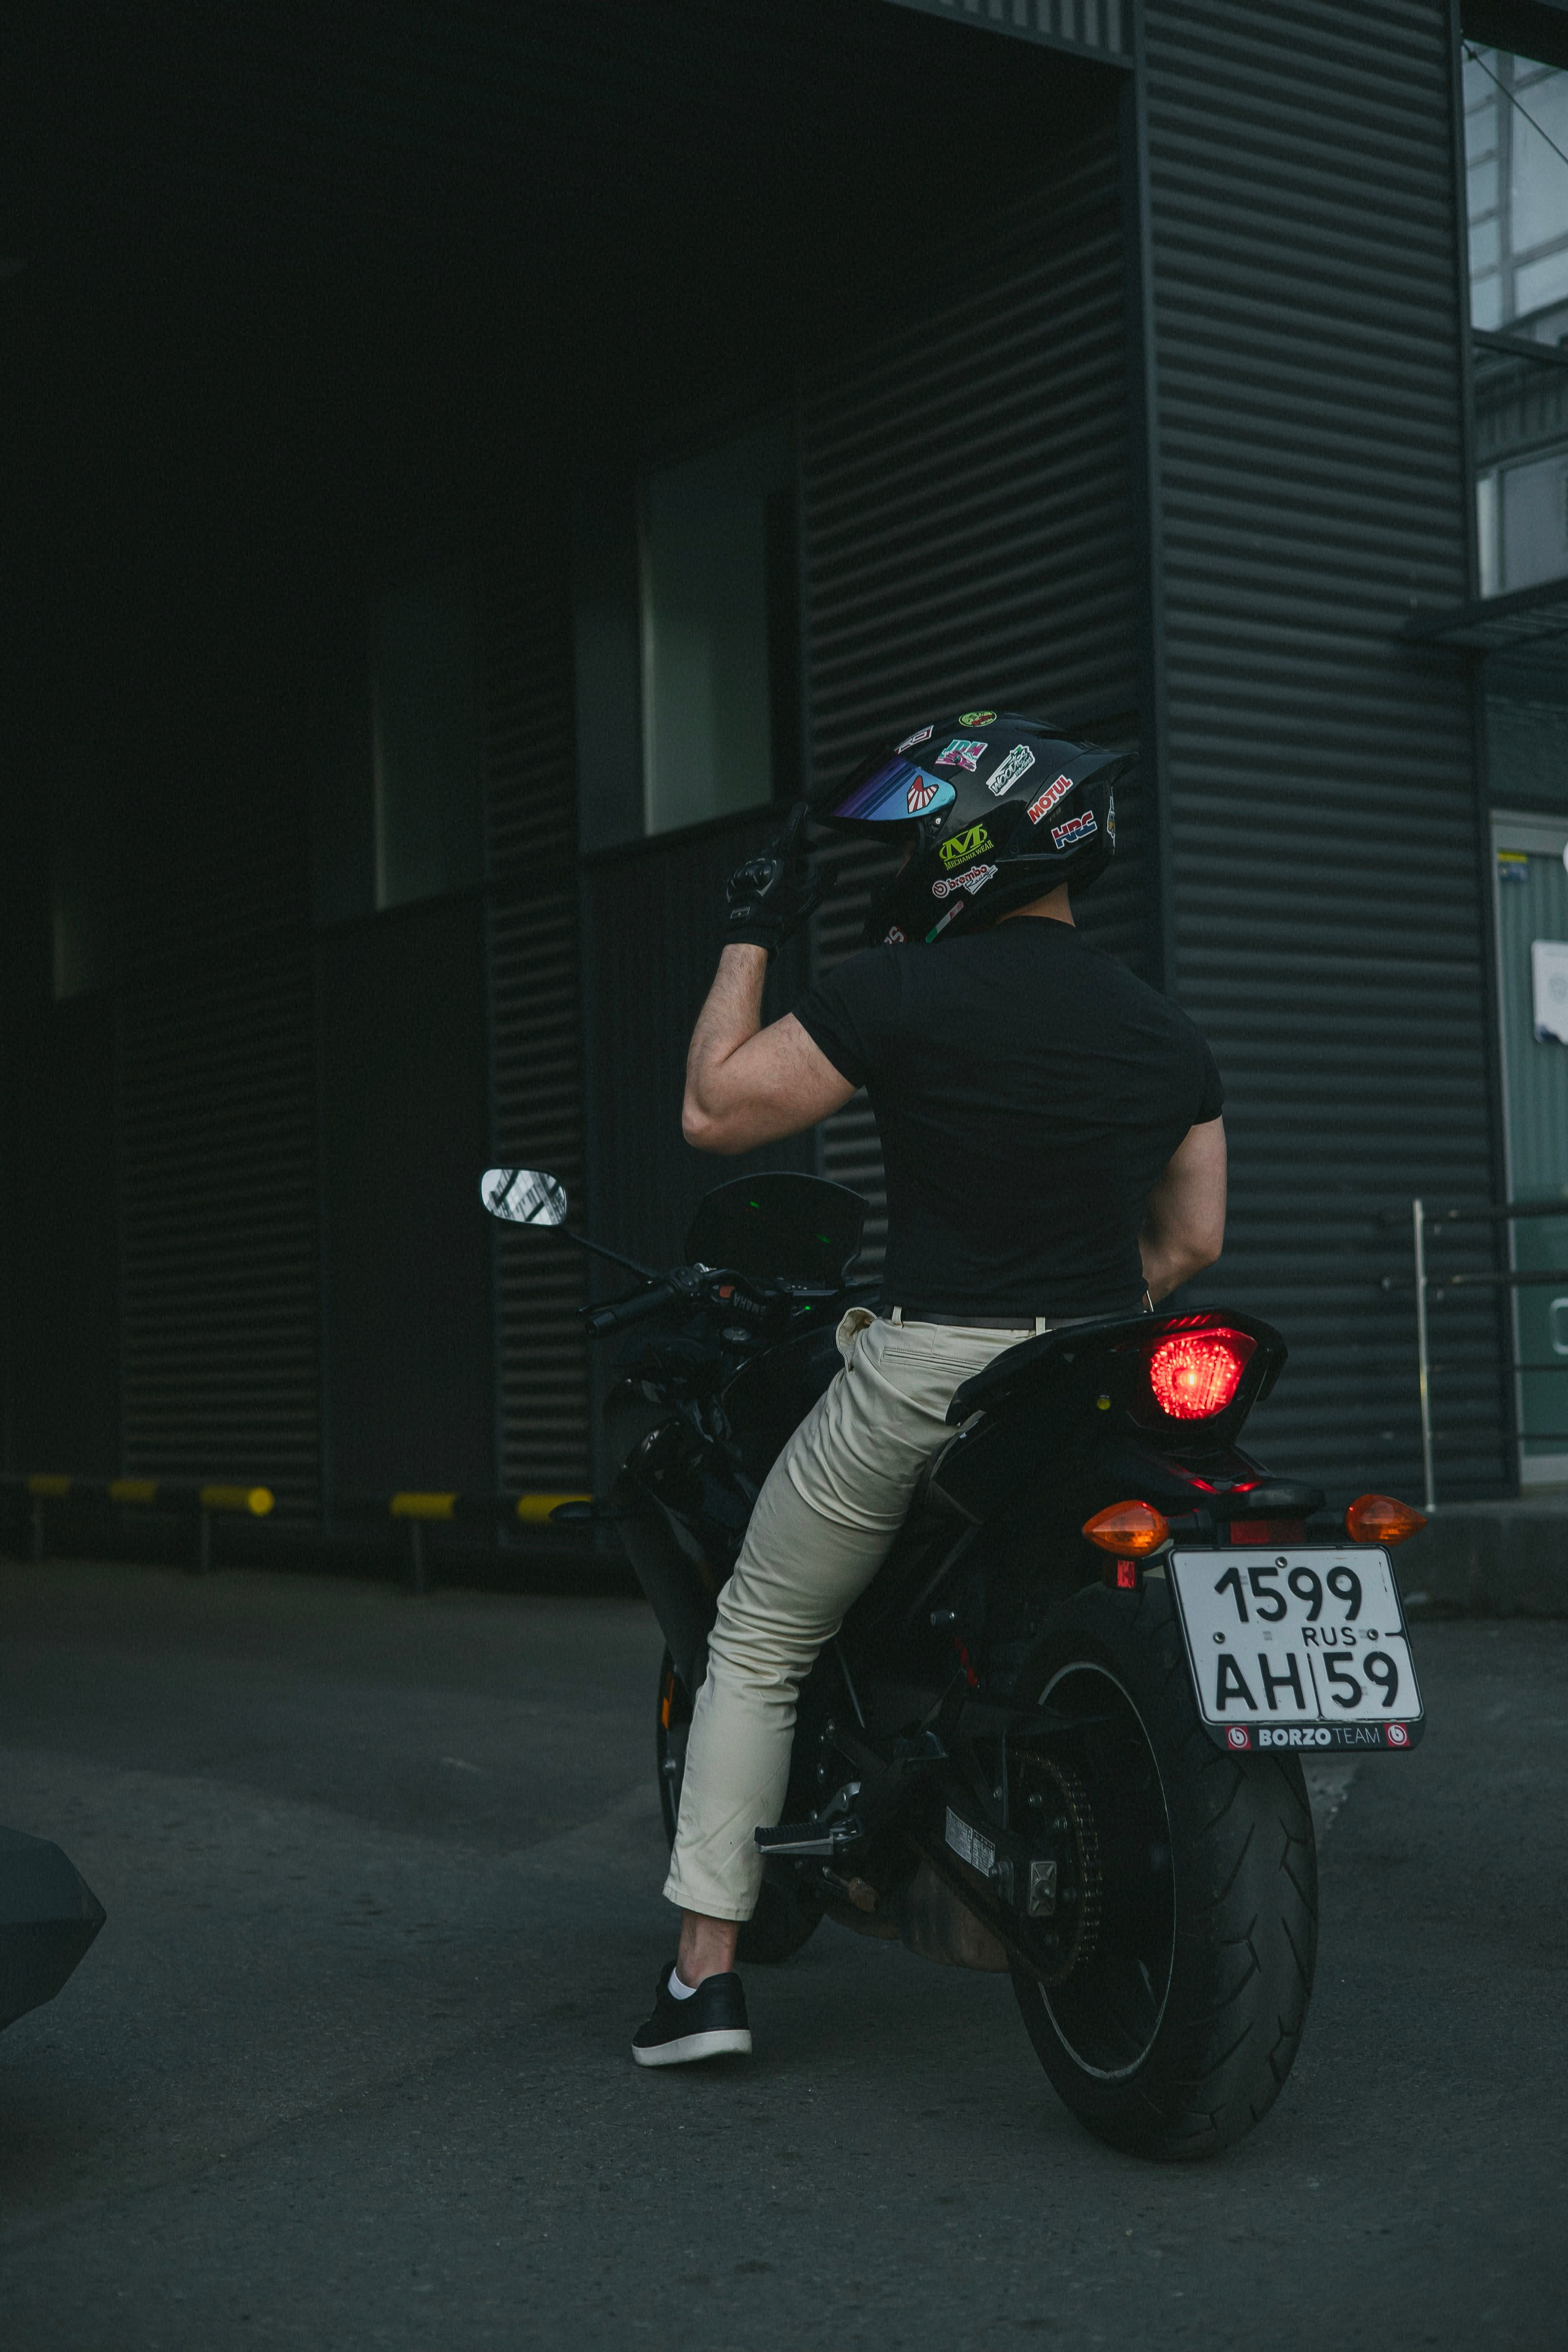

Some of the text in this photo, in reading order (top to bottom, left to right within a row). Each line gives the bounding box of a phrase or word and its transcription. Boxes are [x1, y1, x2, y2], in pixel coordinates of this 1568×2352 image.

[1029, 777, 1071, 823] MOTUL
[1052, 812, 1096, 847] HRC
[943, 839, 994, 870] MECHANIX WEAR
[949, 865, 988, 890] brembo
[965, 870, 992, 889] Racing
[1214, 1566, 1363, 1622] 1599
[1301, 1626, 1357, 1647] RUS
[1216, 1651, 1399, 1711] AH 59
